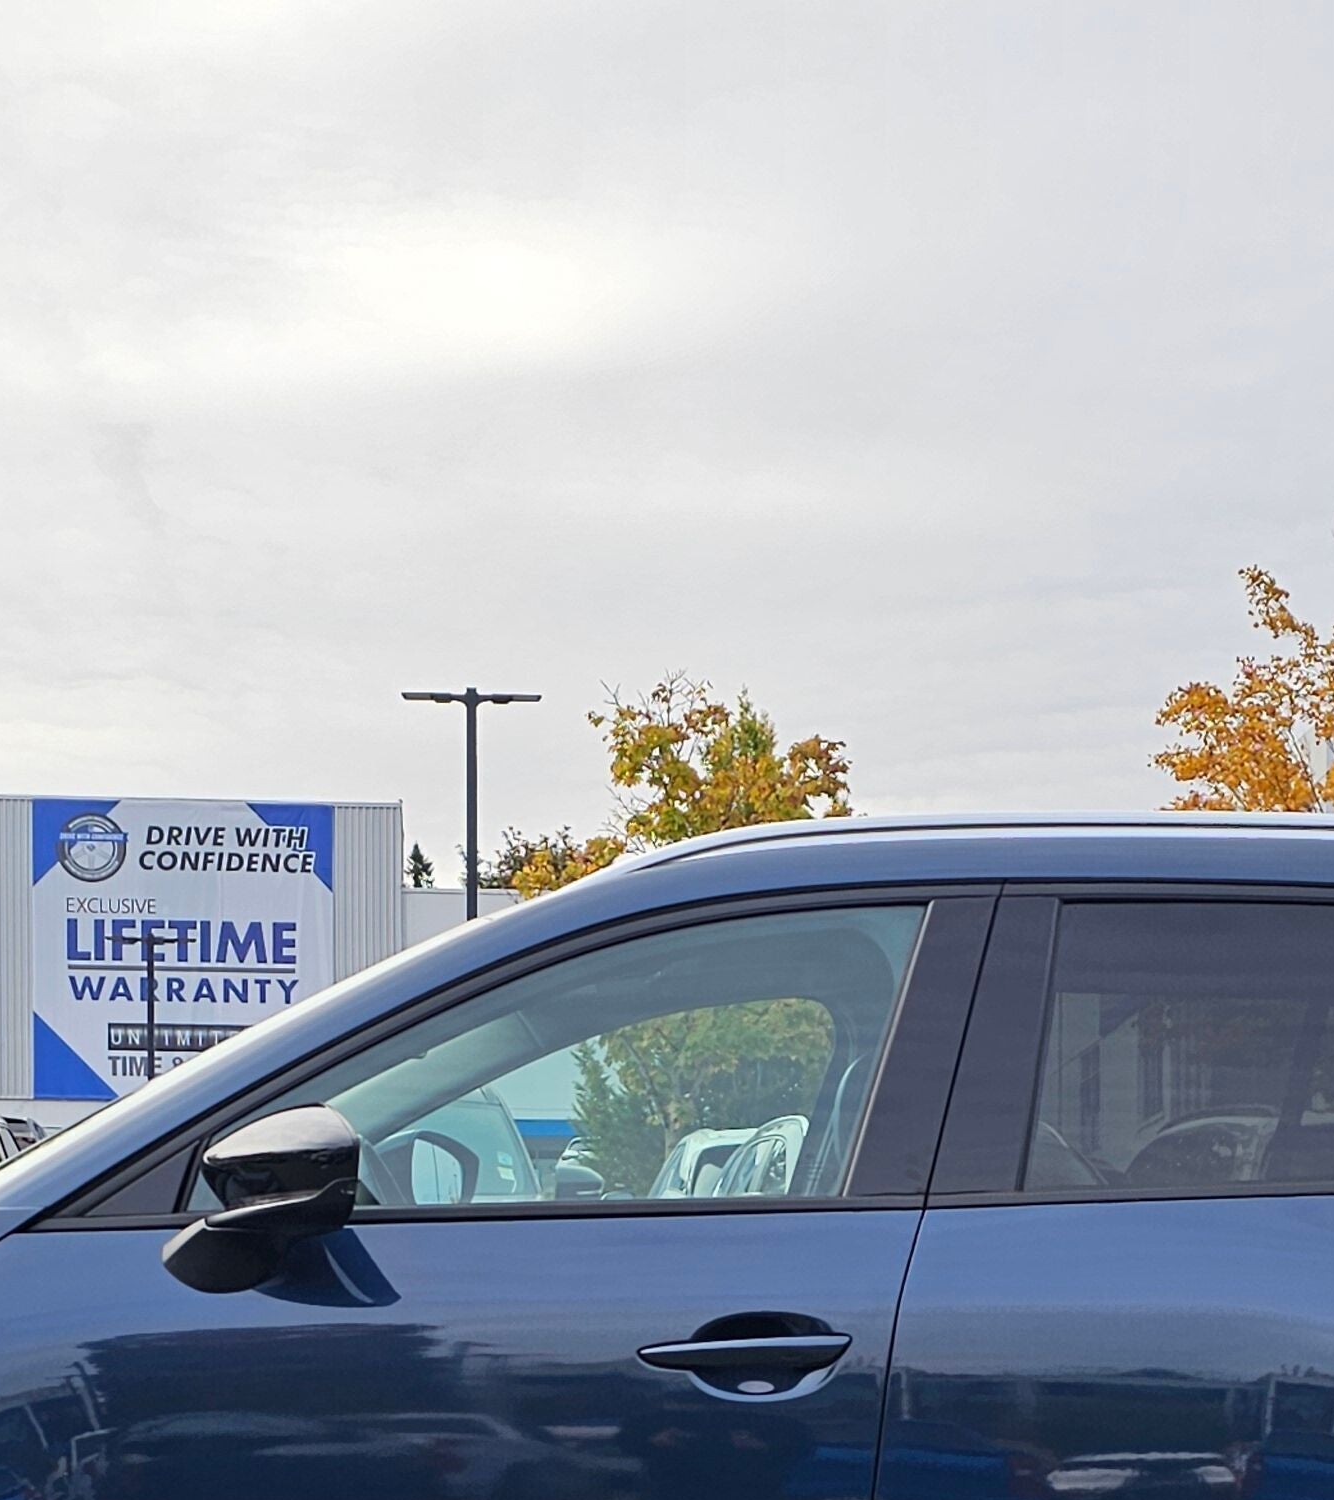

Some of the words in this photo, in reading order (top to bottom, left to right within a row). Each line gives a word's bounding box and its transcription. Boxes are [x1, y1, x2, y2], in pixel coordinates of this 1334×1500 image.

[146, 826, 226, 846] DRIVE
[235, 827, 306, 848] WITH
[138, 851, 315, 873] CONFIDENCE
[66, 897, 157, 914] EXCLUSIVE
[66, 918, 297, 964] LIFETIME
[68, 975, 300, 1004] WARRANTY
